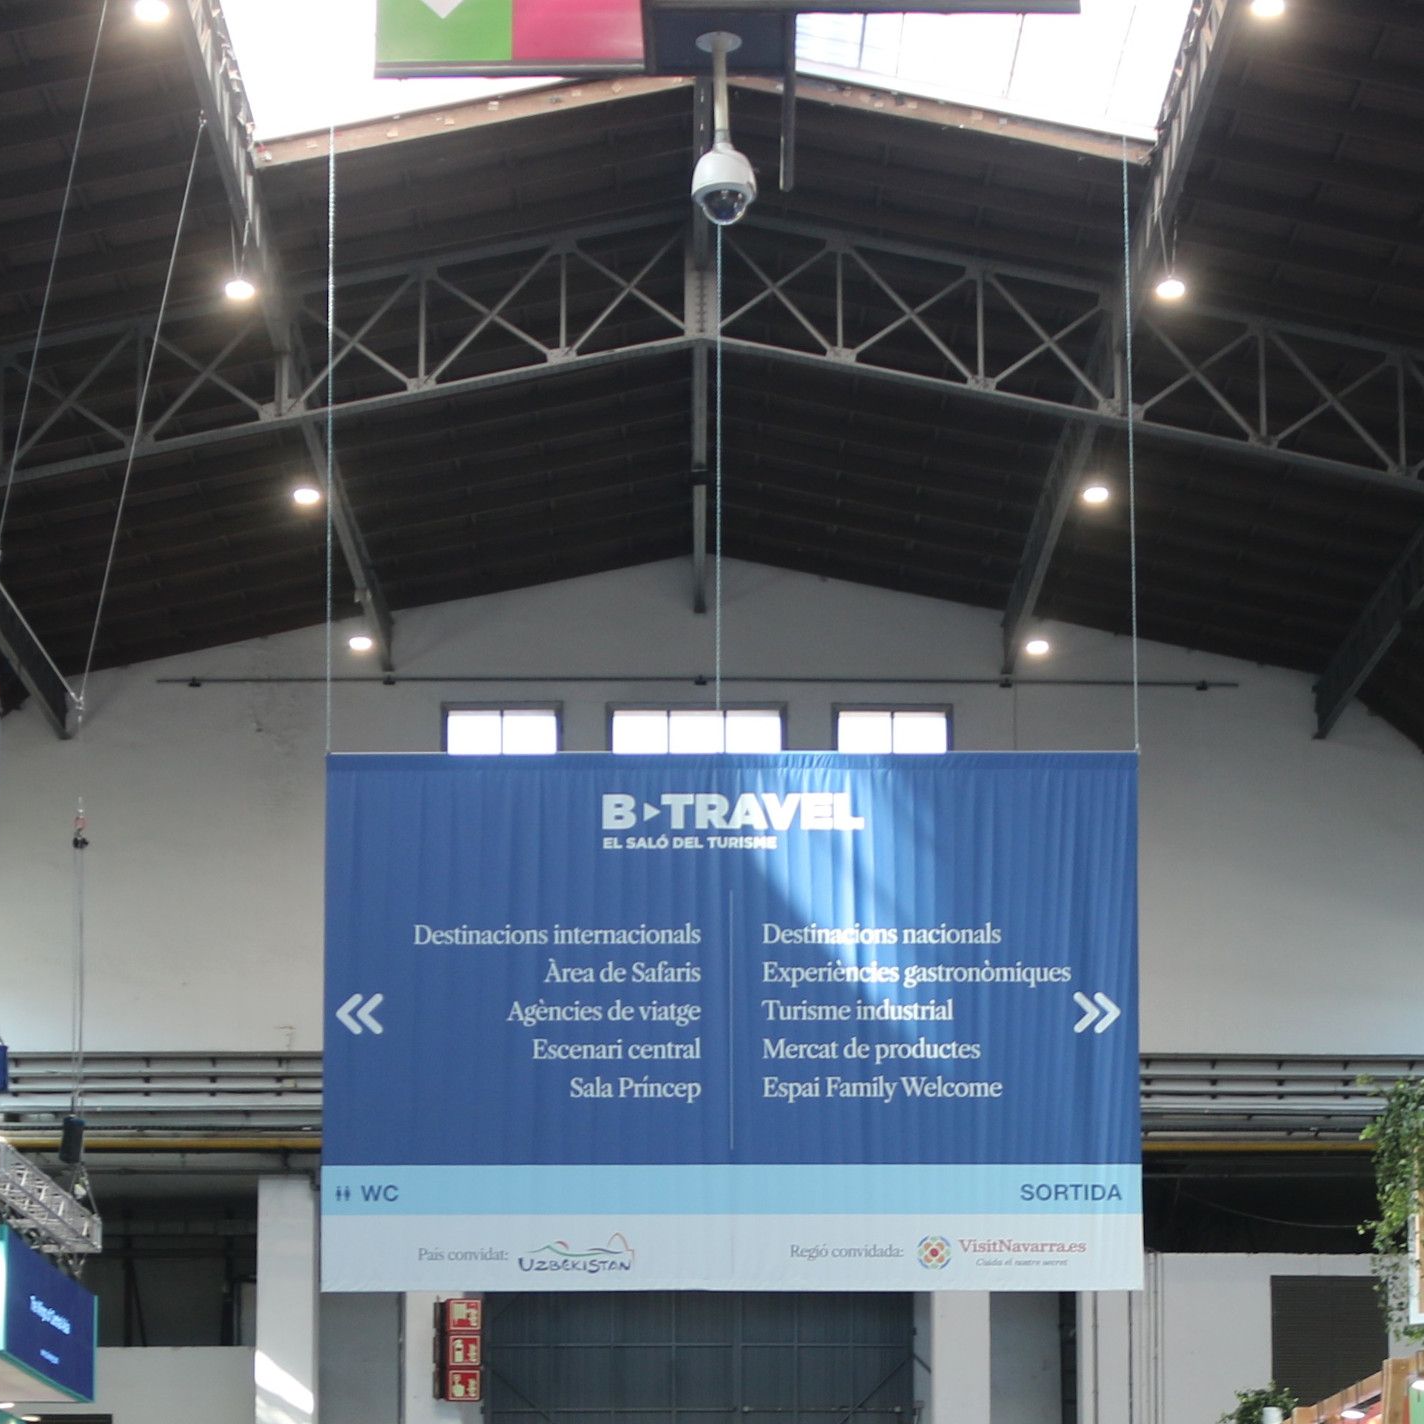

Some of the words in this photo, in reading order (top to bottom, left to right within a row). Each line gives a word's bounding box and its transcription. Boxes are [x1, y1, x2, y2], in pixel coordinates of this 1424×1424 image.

[602, 836, 623, 850] EL
[625, 833, 667, 850] SALÓ
[672, 836, 704, 850] DEL
[707, 836, 777, 850] TURISME
[414, 924, 548, 945] Destinacions
[553, 922, 702, 945] internacionals
[762, 922, 898, 944] Destinacions
[902, 921, 1002, 944] nacionals
[544, 957, 596, 983] Àrea
[599, 960, 627, 983] de
[631, 960, 702, 983] Safaris
[762, 959, 900, 988] Experiències
[902, 959, 1072, 988] gastronòmiques
[506, 998, 603, 1027] Agències
[607, 999, 635, 1022] de
[639, 1000, 702, 1027] viatge
[761, 999, 851, 1021] Turisme
[856, 998, 954, 1021] industrial
[532, 1038, 623, 1060] Escenari
[628, 1037, 702, 1060] central
[762, 1038, 839, 1059] Mercat
[843, 1036, 871, 1059] de
[874, 1036, 982, 1065] productes
[569, 1076, 613, 1098] Sala
[618, 1074, 702, 1104] Príncep
[762, 1076, 820, 1103] Espai
[825, 1075, 898, 1104] Family
[900, 1075, 1004, 1098] Welcome
[361, 1184, 400, 1202] WC
[1019, 1183, 1123, 1202] SORTIDA
[417, 1246, 446, 1262] País
[447, 1247, 509, 1262] convidat:
[518, 1257, 631, 1274] UZBEKISTAN
[789, 1243, 828, 1262] Regió
[830, 1243, 905, 1259] convidada:
